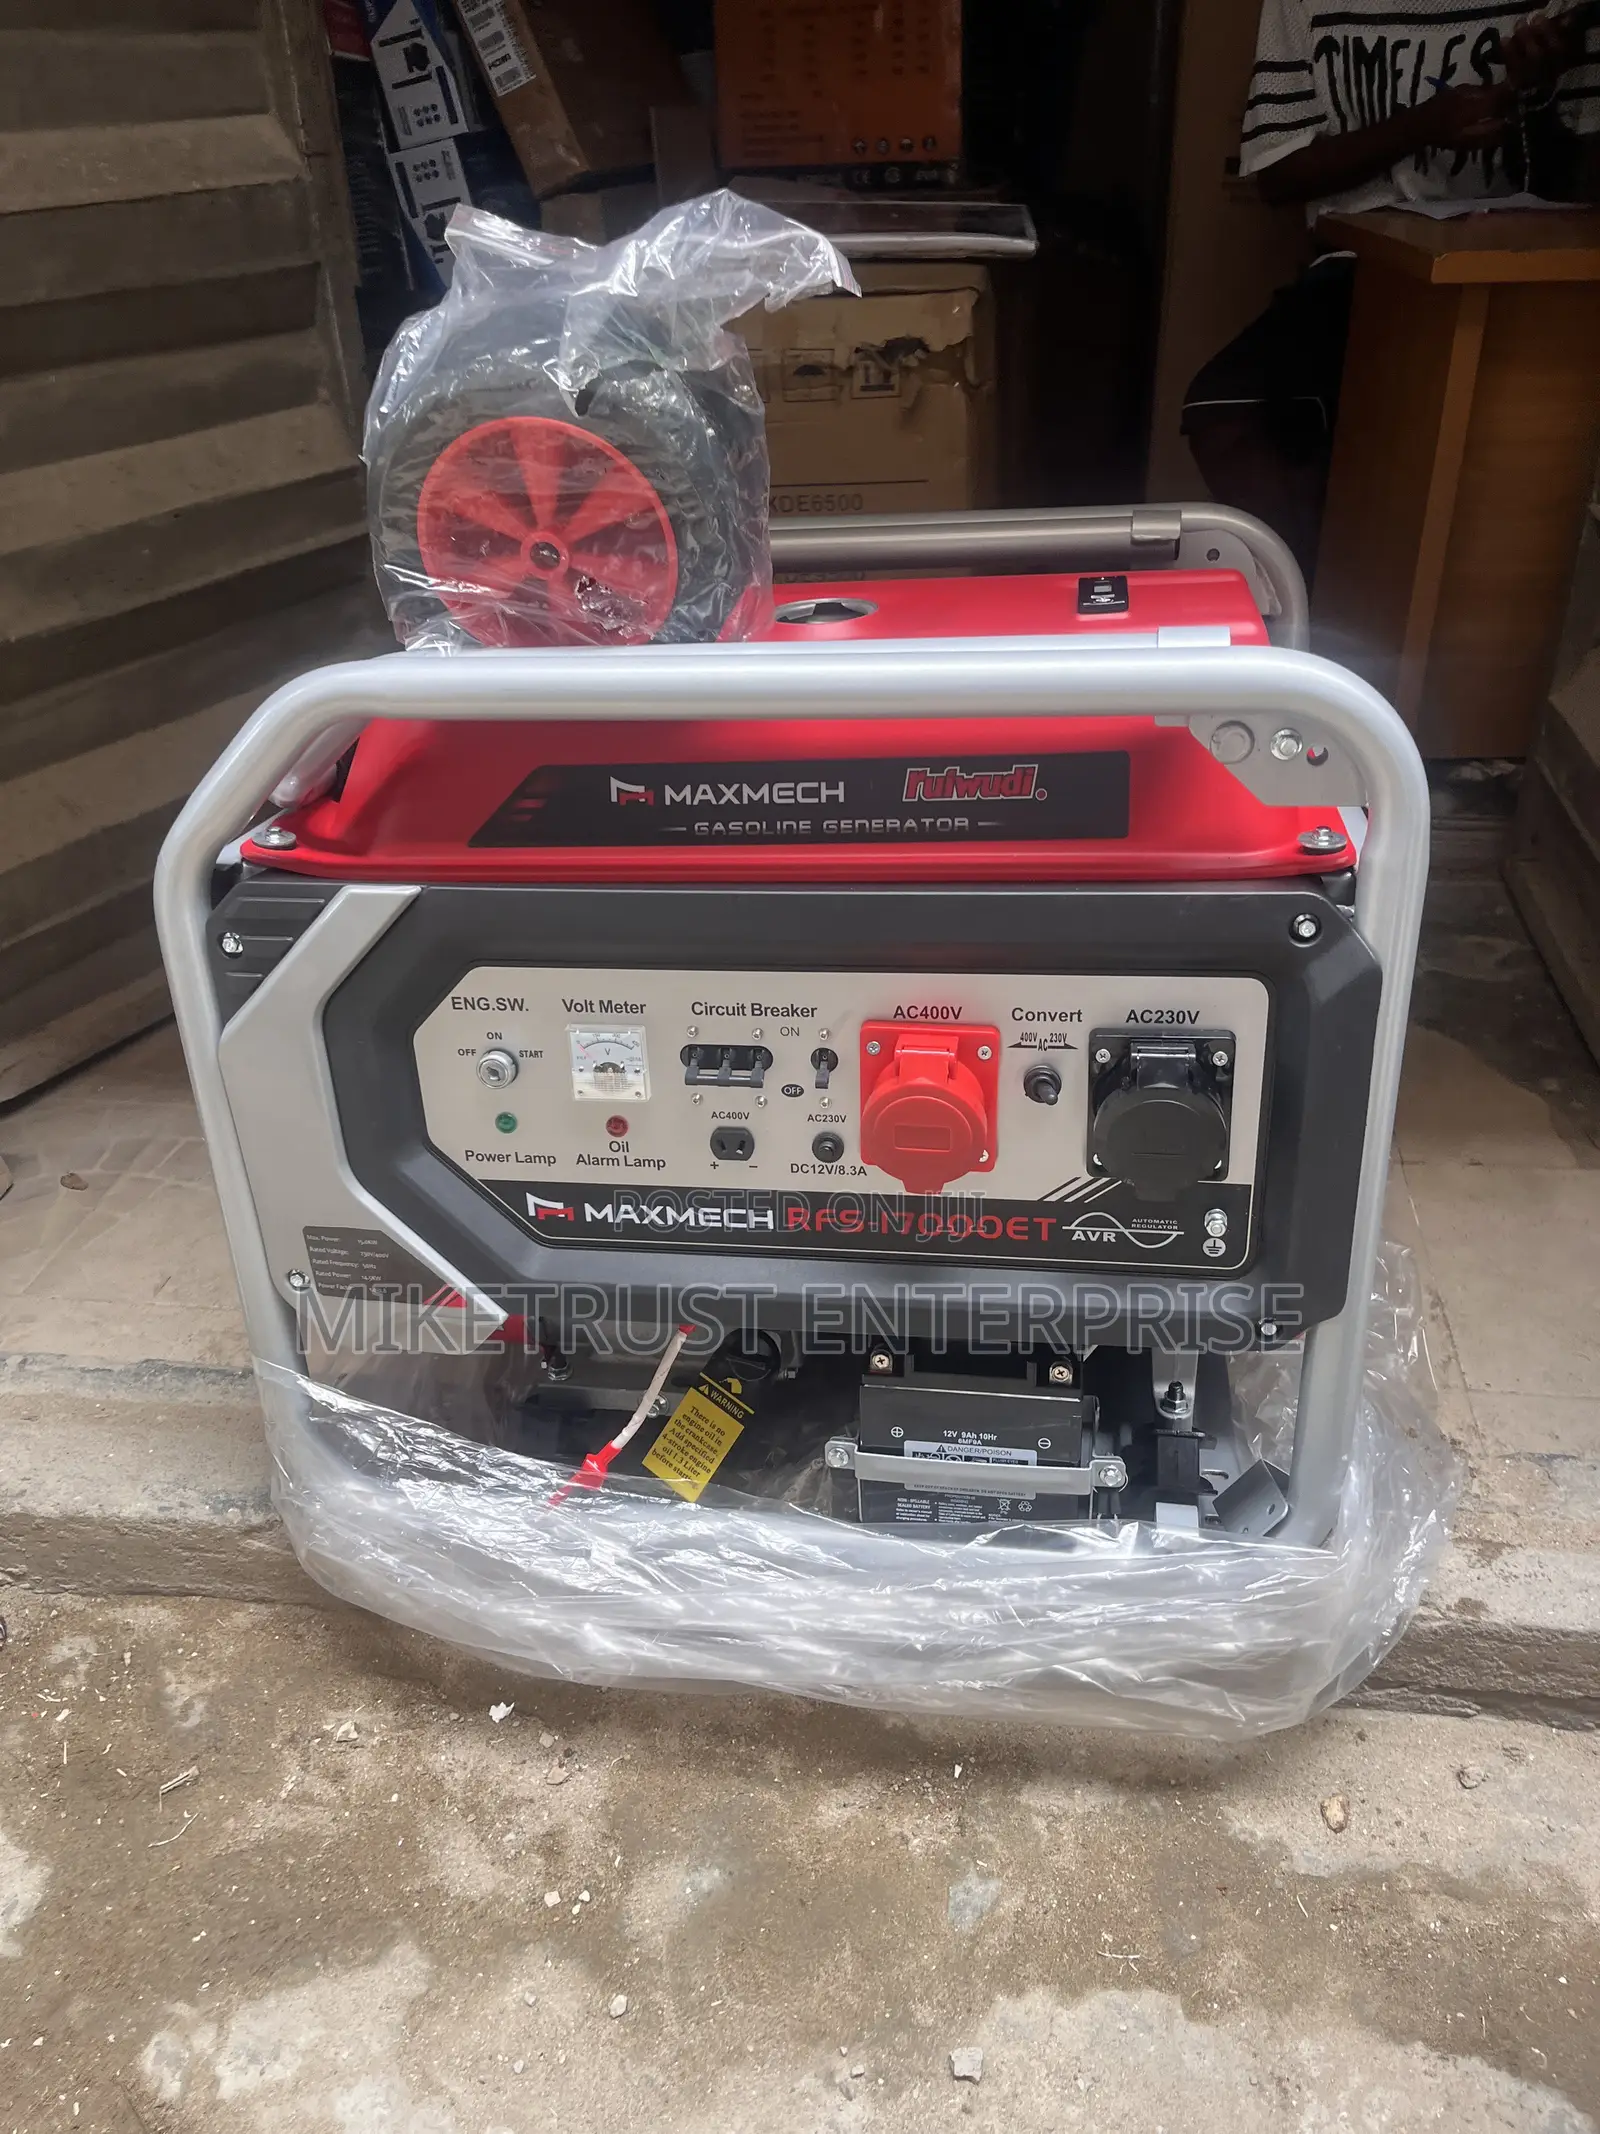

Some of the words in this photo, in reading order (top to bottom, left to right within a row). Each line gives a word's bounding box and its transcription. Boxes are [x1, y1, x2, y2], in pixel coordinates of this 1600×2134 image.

[664, 781, 845, 806] MAXMECH
[694, 820, 811, 836] GASOLINE
[823, 817, 969, 834] GENERATOR
[451, 996, 529, 1012] ENG.SW.
[562, 998, 597, 1014] Volt
[599, 1000, 646, 1015] Meter
[691, 1001, 747, 1018] Circuit
[751, 1003, 818, 1019] Breaker
[893, 1005, 963, 1020] AC400V
[1011, 1007, 1083, 1024] Convert
[1126, 1009, 1200, 1026] AC230V
[486, 1031, 502, 1040] ON
[780, 1026, 800, 1037] ON
[1020, 1031, 1037, 1043] 400V
[1049, 1032, 1067, 1044] 230V
[457, 1048, 476, 1057] OFF
[604, 1048, 611, 1056] V
[1037, 1038, 1048, 1052] AC
[519, 1050, 543, 1059] START
[783, 1086, 802, 1096] OFF
[711, 1111, 750, 1121] AC400V
[807, 1113, 847, 1124] AC230V
[609, 1140, 629, 1154] Oil
[465, 1150, 511, 1164] Power
[514, 1152, 557, 1167] Lamp
[576, 1154, 621, 1168] Alarm
[624, 1156, 666, 1171] Lamp
[790, 1162, 867, 1177] DC12V/8.3A
[584, 1202, 774, 1230] MAXMECH
[1072, 1230, 1117, 1243] AVR
[711, 1390, 744, 1419] WARNING
[674, 1419, 685, 1430] the
[690, 1406, 710, 1425] There
[709, 1420, 717, 1429] is
[716, 1428, 726, 1437] no
[682, 1413, 705, 1432] engine
[704, 1428, 716, 1440] oil
[715, 1437, 723, 1446] in
[961, 1431, 977, 1439] 9Ah
[979, 1432, 998, 1441] 10Hr
[662, 1433, 689, 1456] 4-stroke
[689, 1454, 712, 1474] engine
[669, 1428, 684, 1441] Add
[683, 1437, 715, 1464] specified
[947, 1446, 1012, 1456] DANGER/POISON
[651, 1448, 673, 1468] before
[662, 1445, 673, 1455] oil
[684, 1461, 701, 1477] Liter
